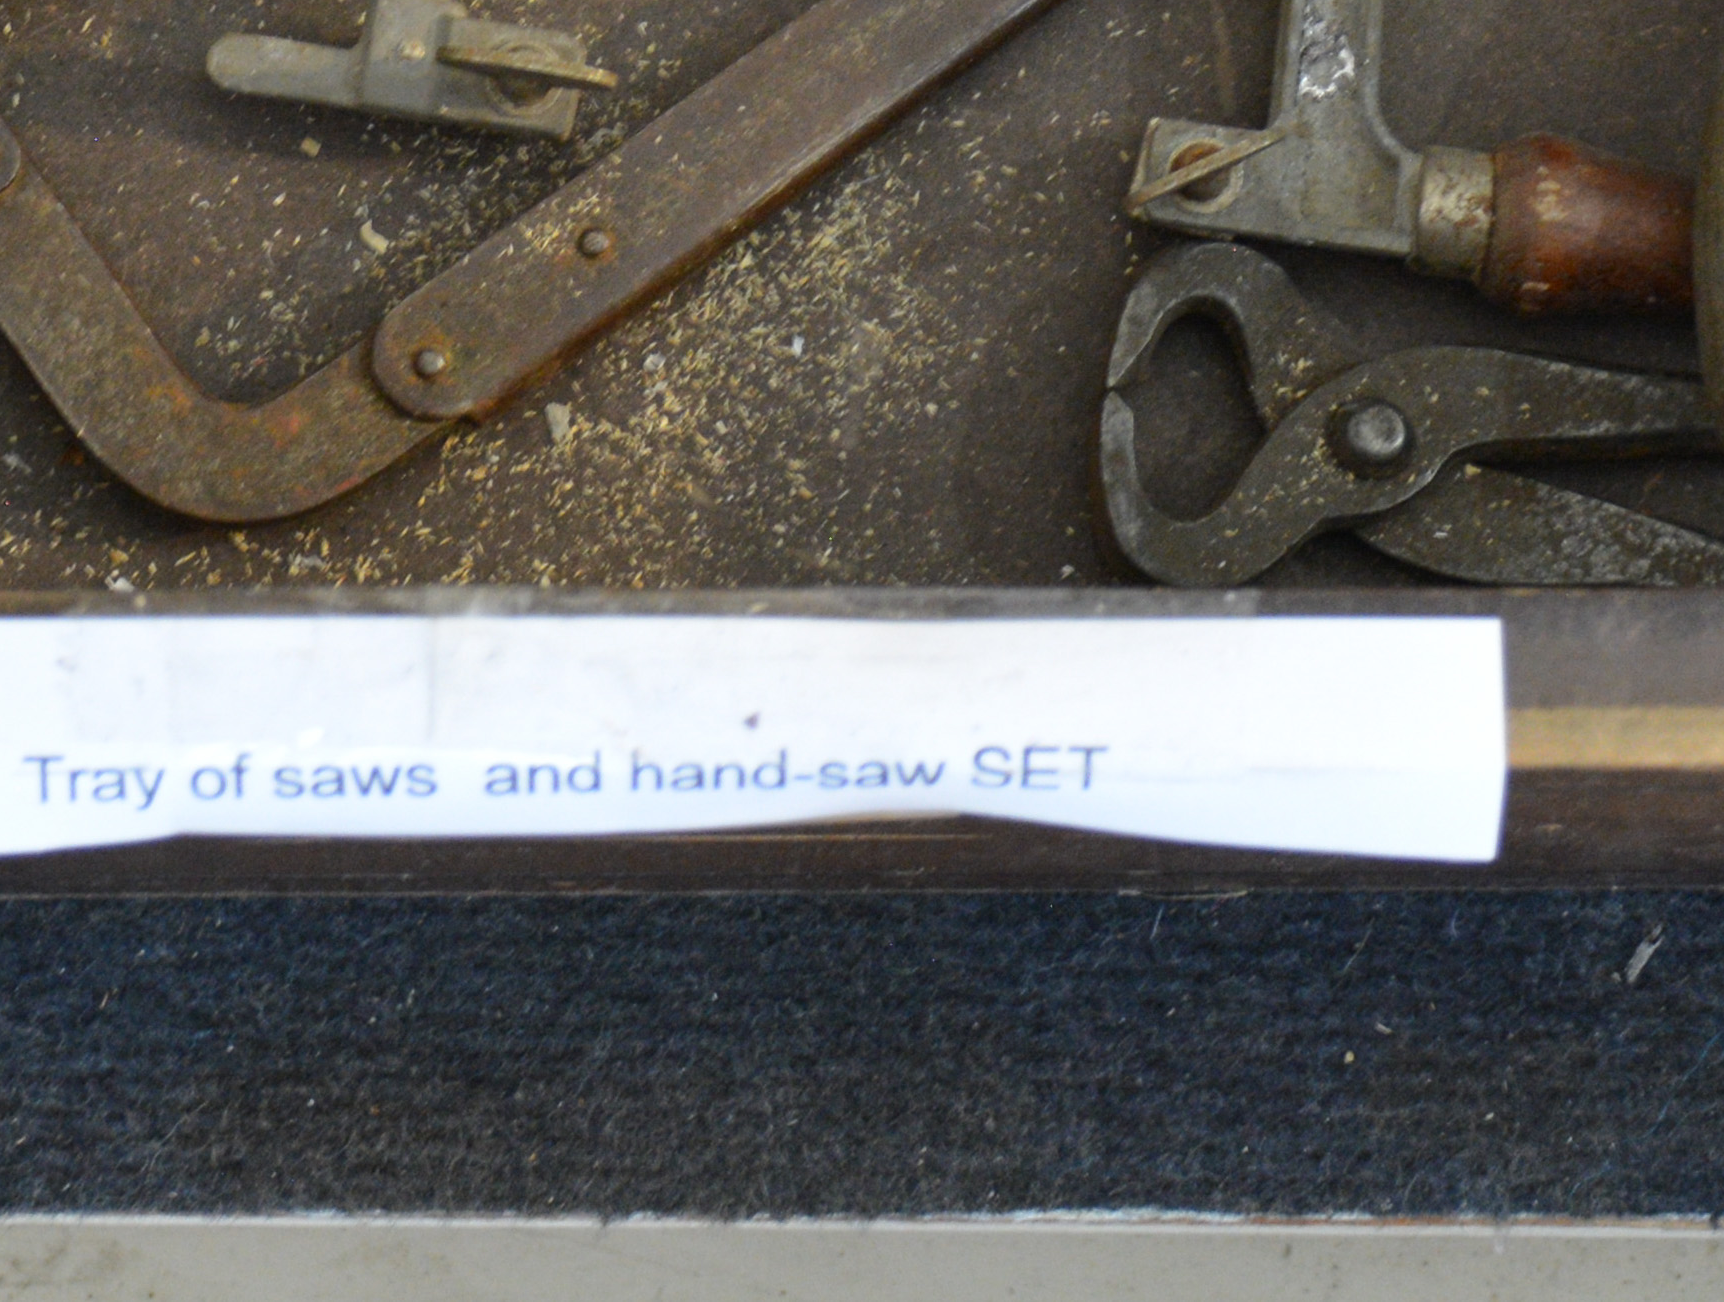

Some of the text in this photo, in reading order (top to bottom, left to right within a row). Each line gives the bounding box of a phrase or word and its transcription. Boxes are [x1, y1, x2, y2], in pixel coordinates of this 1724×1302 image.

[22, 754, 166, 811] Tray
[190, 752, 251, 800] of
[273, 763, 438, 799] saws
[484, 749, 601, 796] and
[629, 748, 946, 791] hand-saw
[970, 744, 1109, 791] SET
